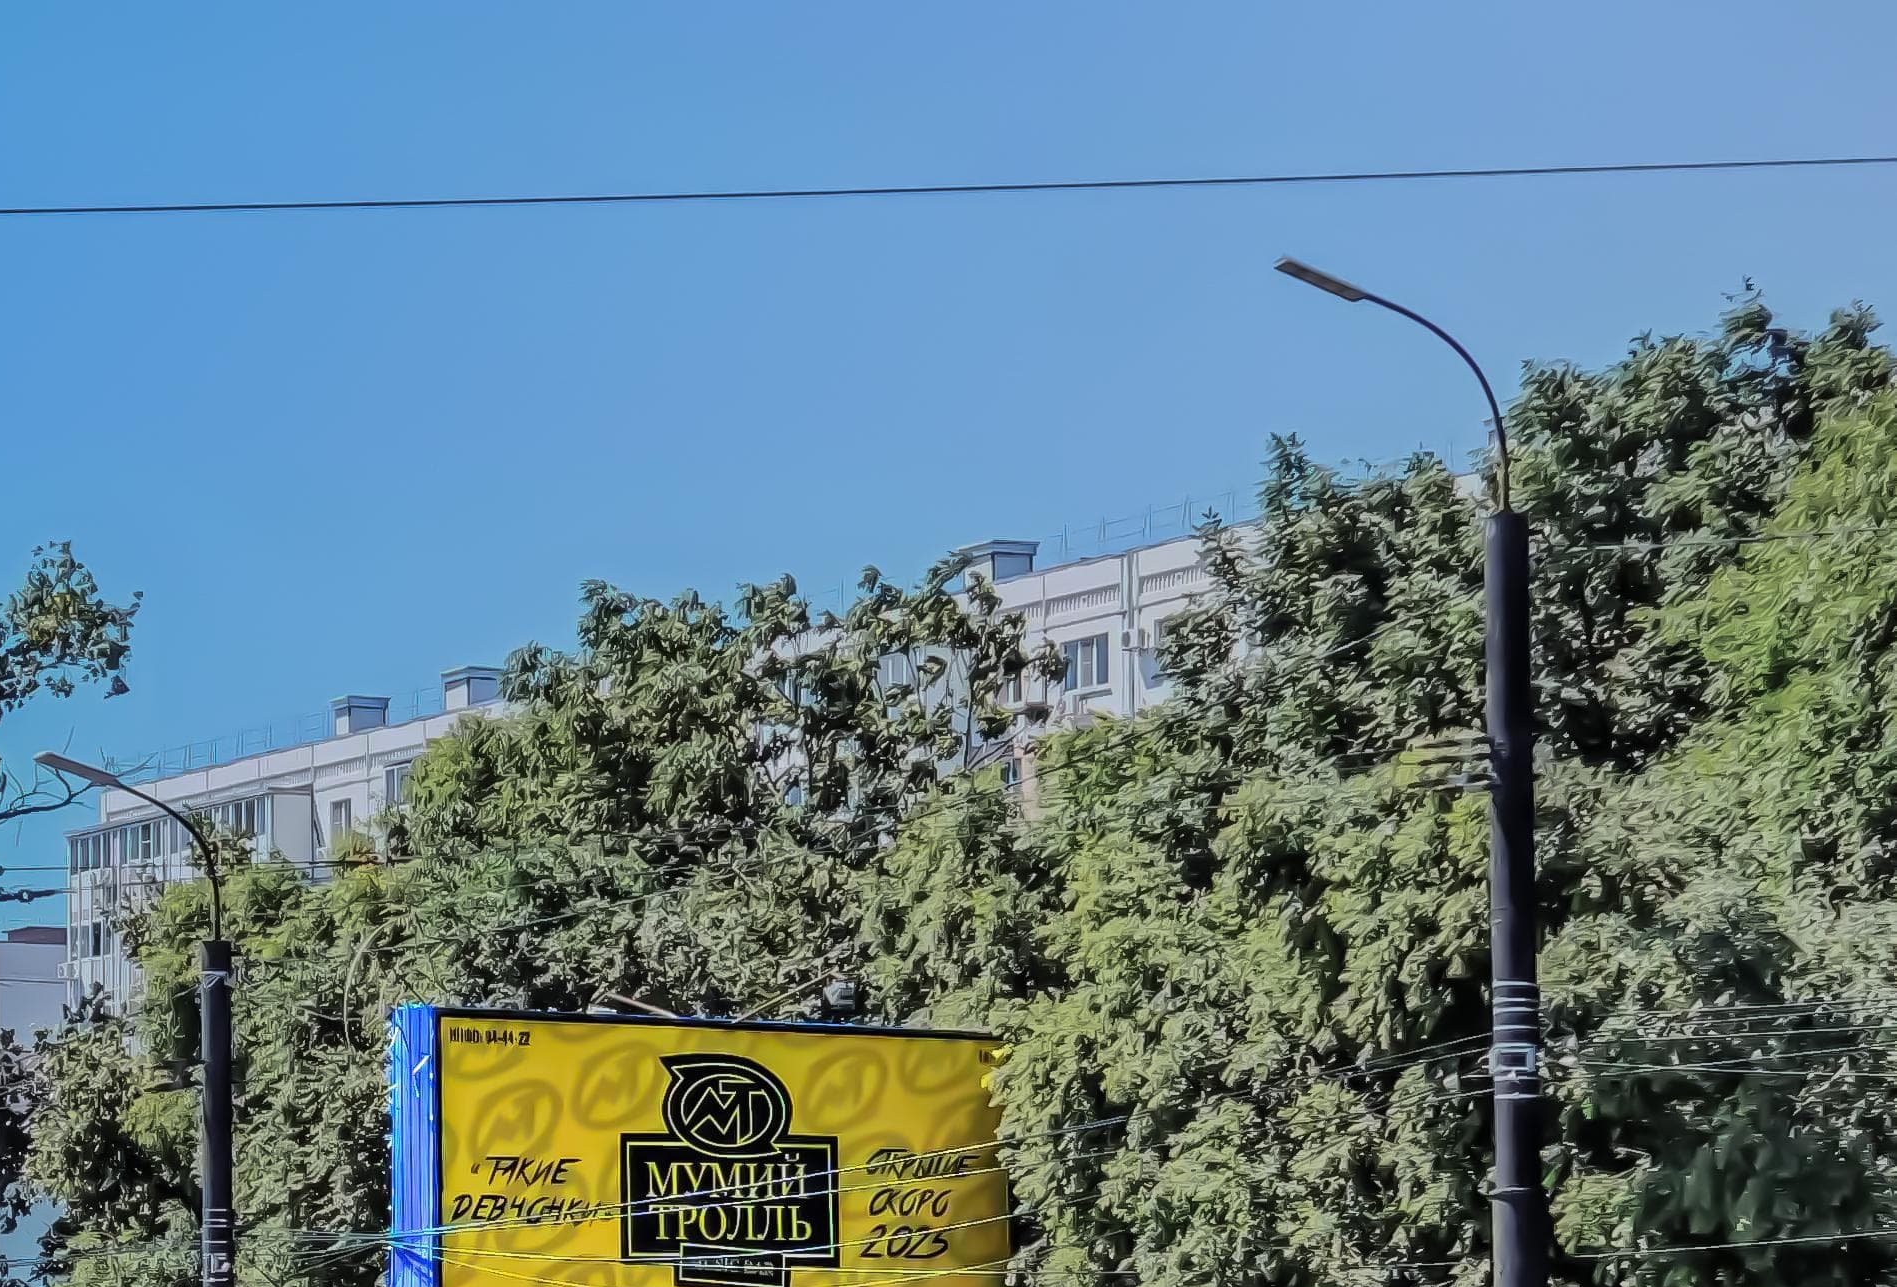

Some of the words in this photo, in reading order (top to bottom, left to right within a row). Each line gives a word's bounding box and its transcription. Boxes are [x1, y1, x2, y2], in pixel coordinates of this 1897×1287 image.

[644, 1152, 808, 1199] МУМИЙ
[869, 1187, 952, 1217] СКОРО
[649, 1204, 813, 1241] ТРОЛЛЬ
[860, 1224, 949, 1258] 2025
